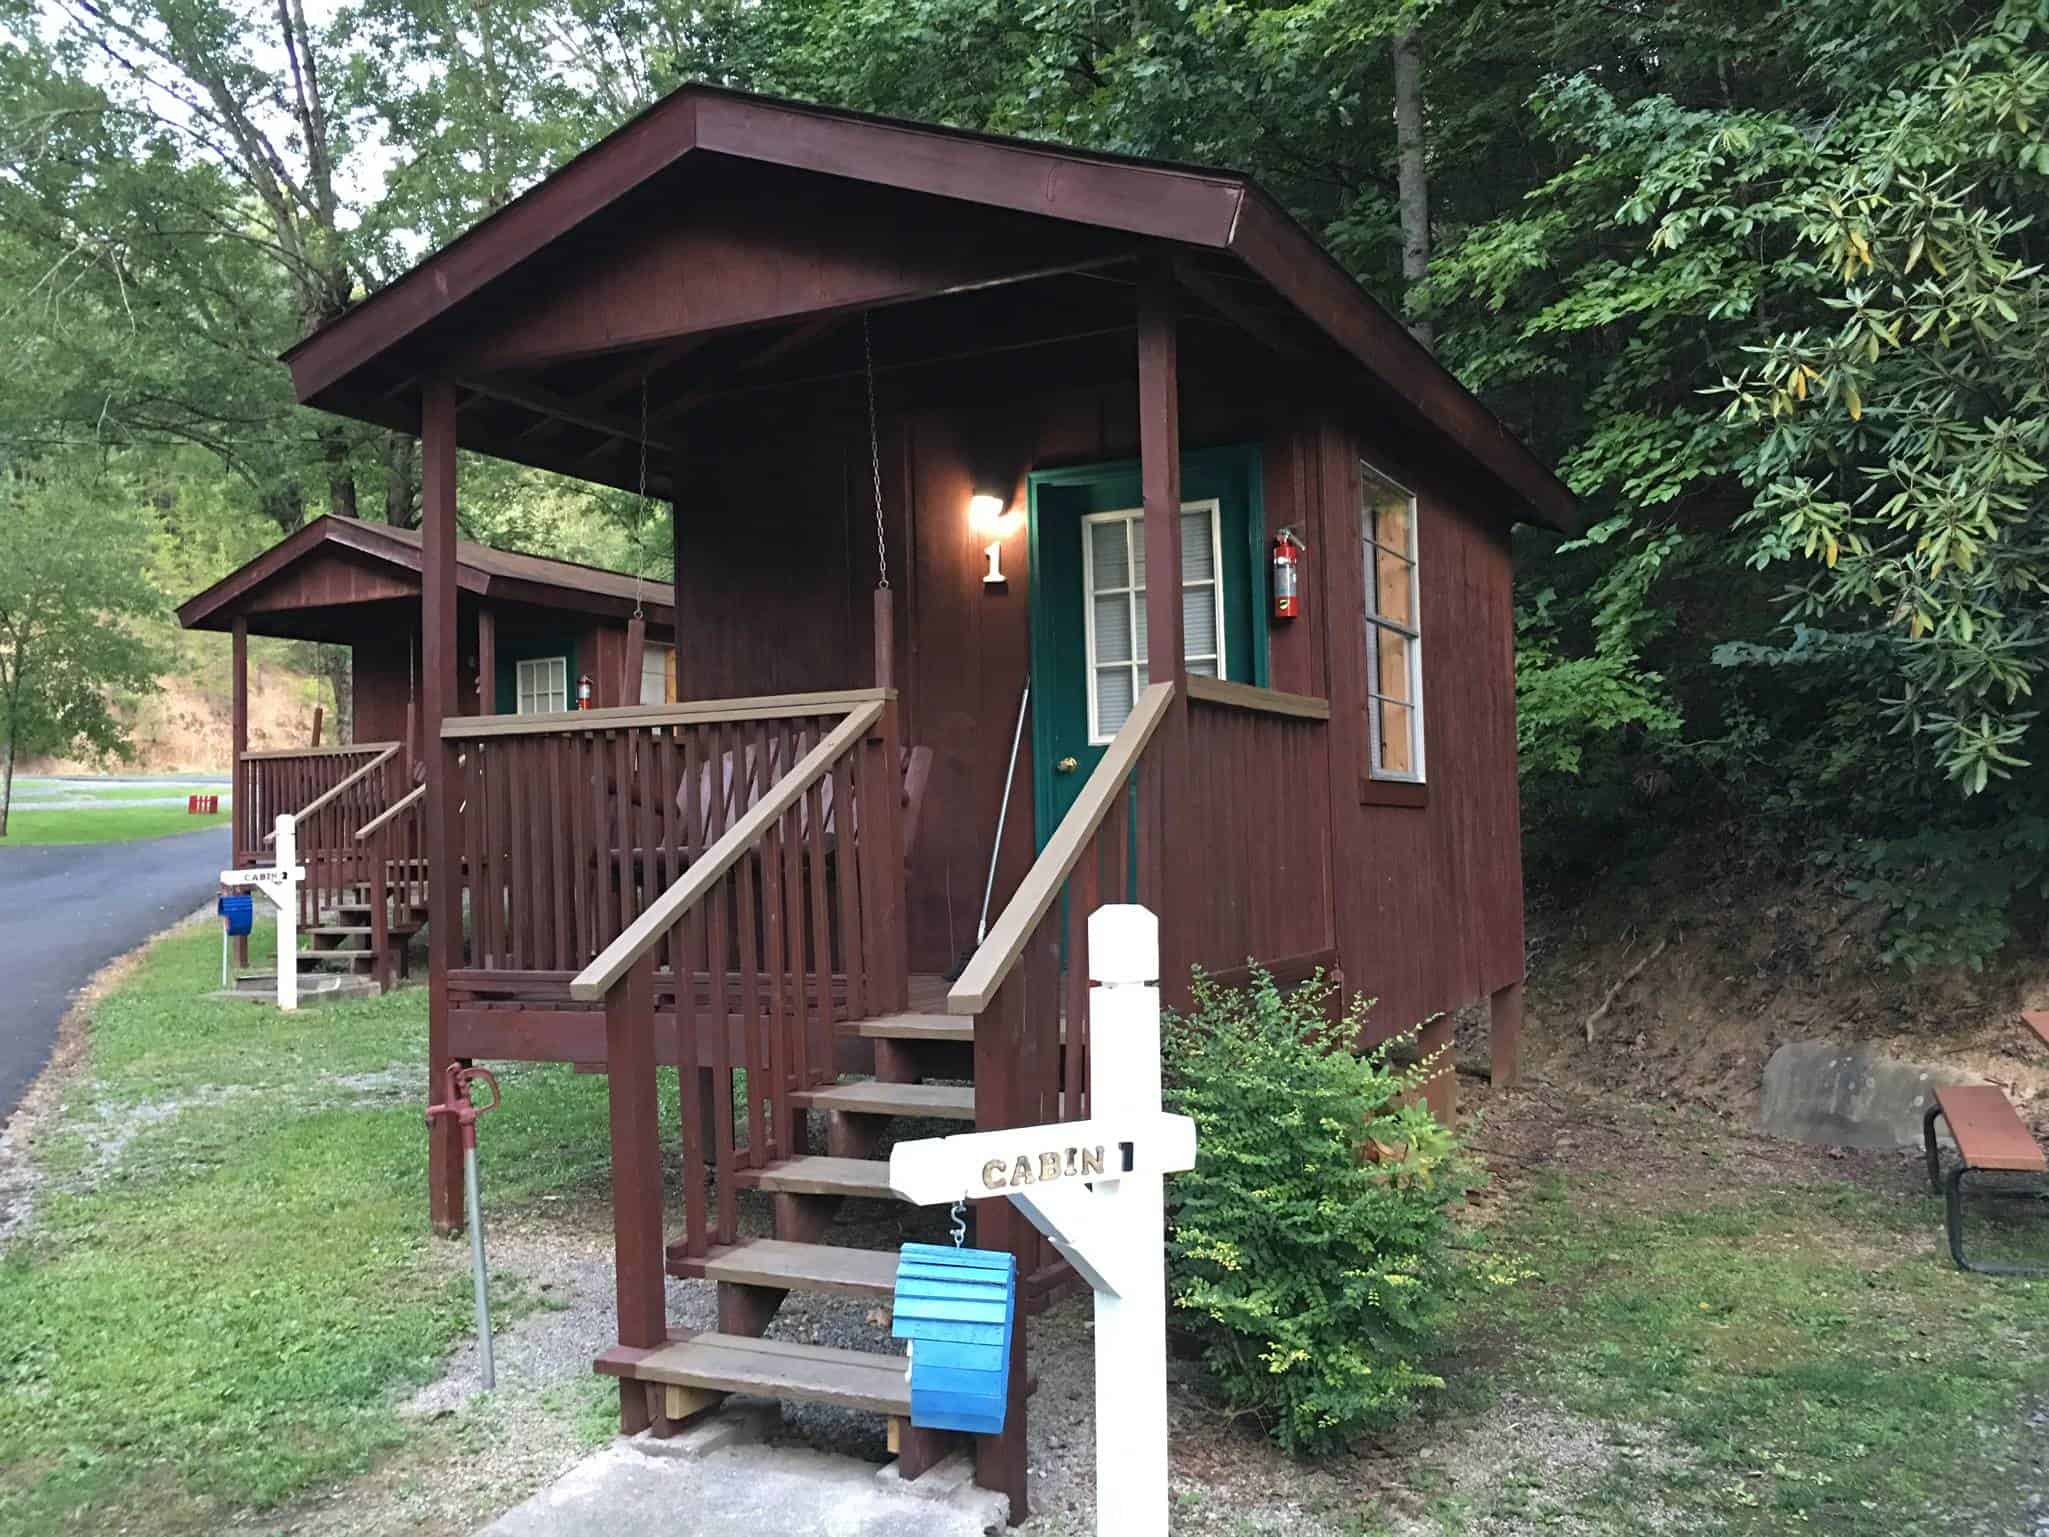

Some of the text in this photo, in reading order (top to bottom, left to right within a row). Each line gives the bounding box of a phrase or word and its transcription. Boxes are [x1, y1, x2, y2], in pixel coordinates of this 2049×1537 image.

[983, 542, 1006, 583] 1
[244, 872, 277, 881] CABIN
[982, 1141, 1134, 1190] CABIN 1
